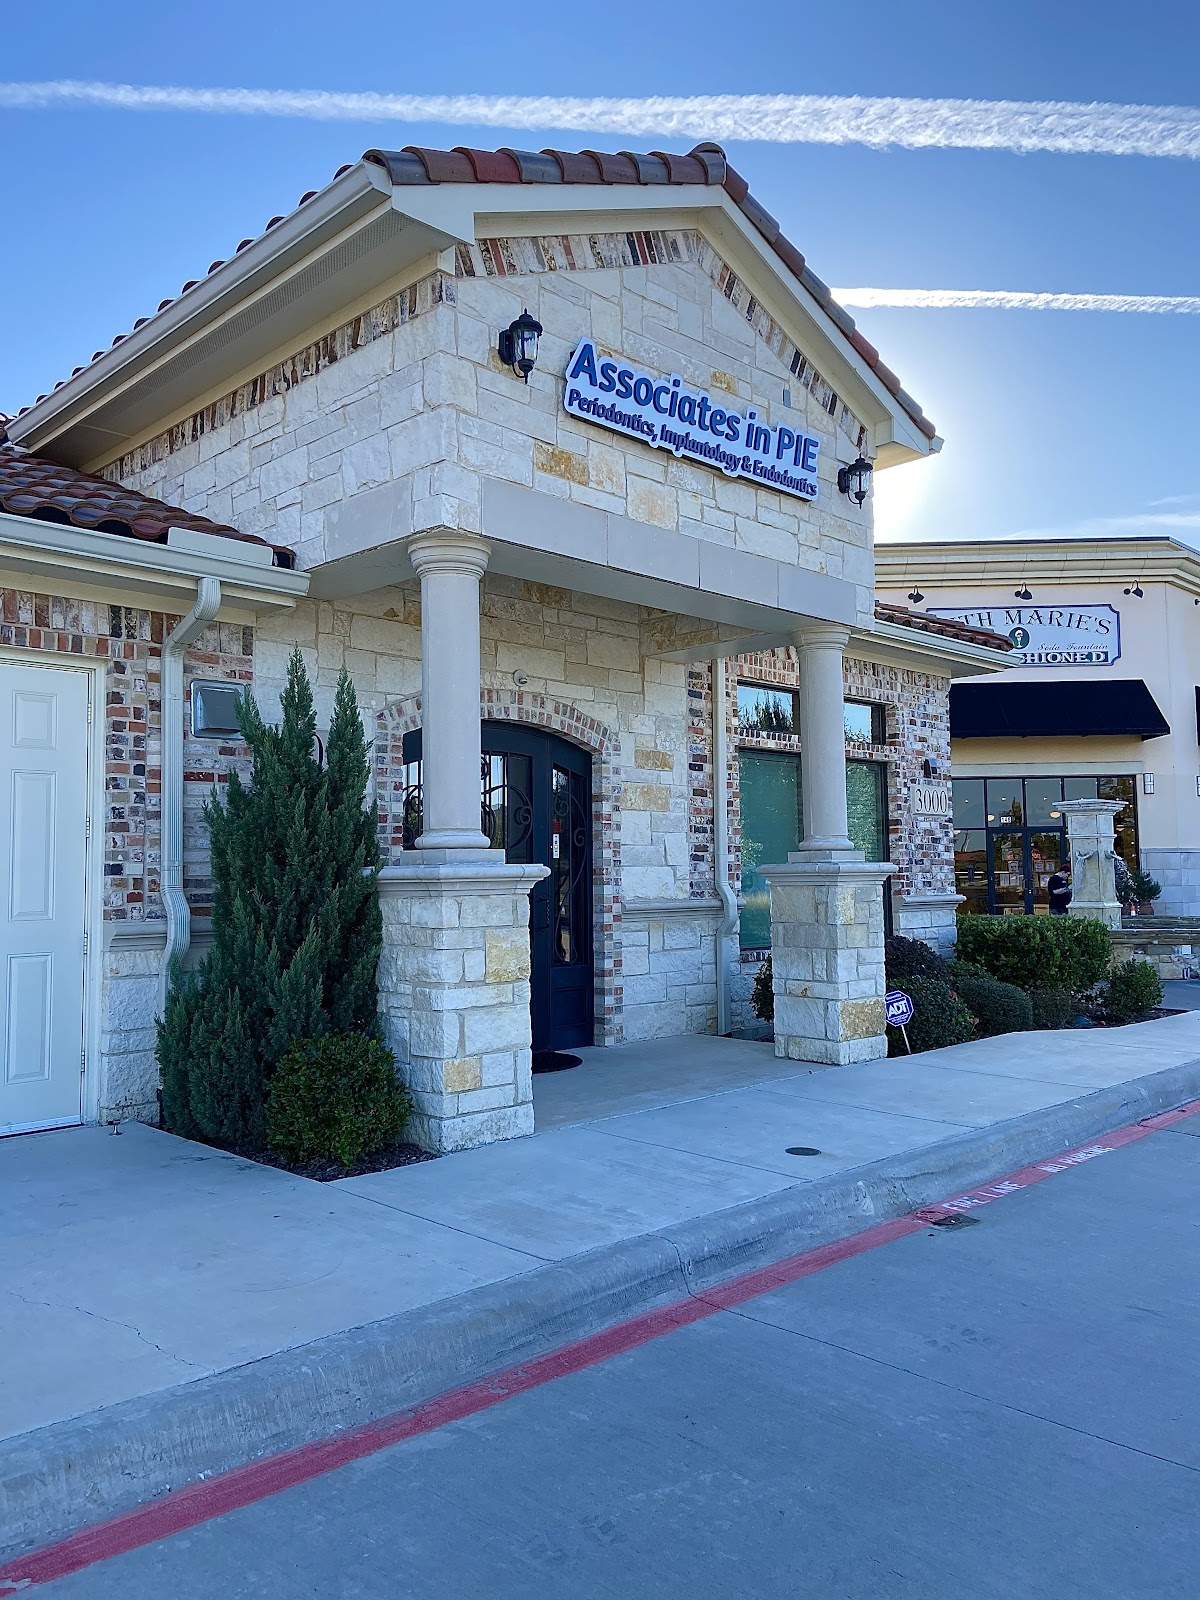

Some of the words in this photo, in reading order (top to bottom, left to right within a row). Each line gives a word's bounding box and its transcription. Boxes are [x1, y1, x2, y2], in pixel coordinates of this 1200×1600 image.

[570, 343, 741, 442] Associates
[746, 412, 771, 455] in
[776, 426, 819, 473] PIE
[568, 389, 657, 442] Periodontics,
[660, 424, 741, 474] Implantology
[741, 456, 752, 472] &
[753, 459, 818, 497] Endodontics
[1004, 609, 1113, 635] MARIE'S
[1066, 642, 1109, 650] Fountain
[915, 788, 948, 814] 3000
[888, 1000, 907, 1017] ADT
